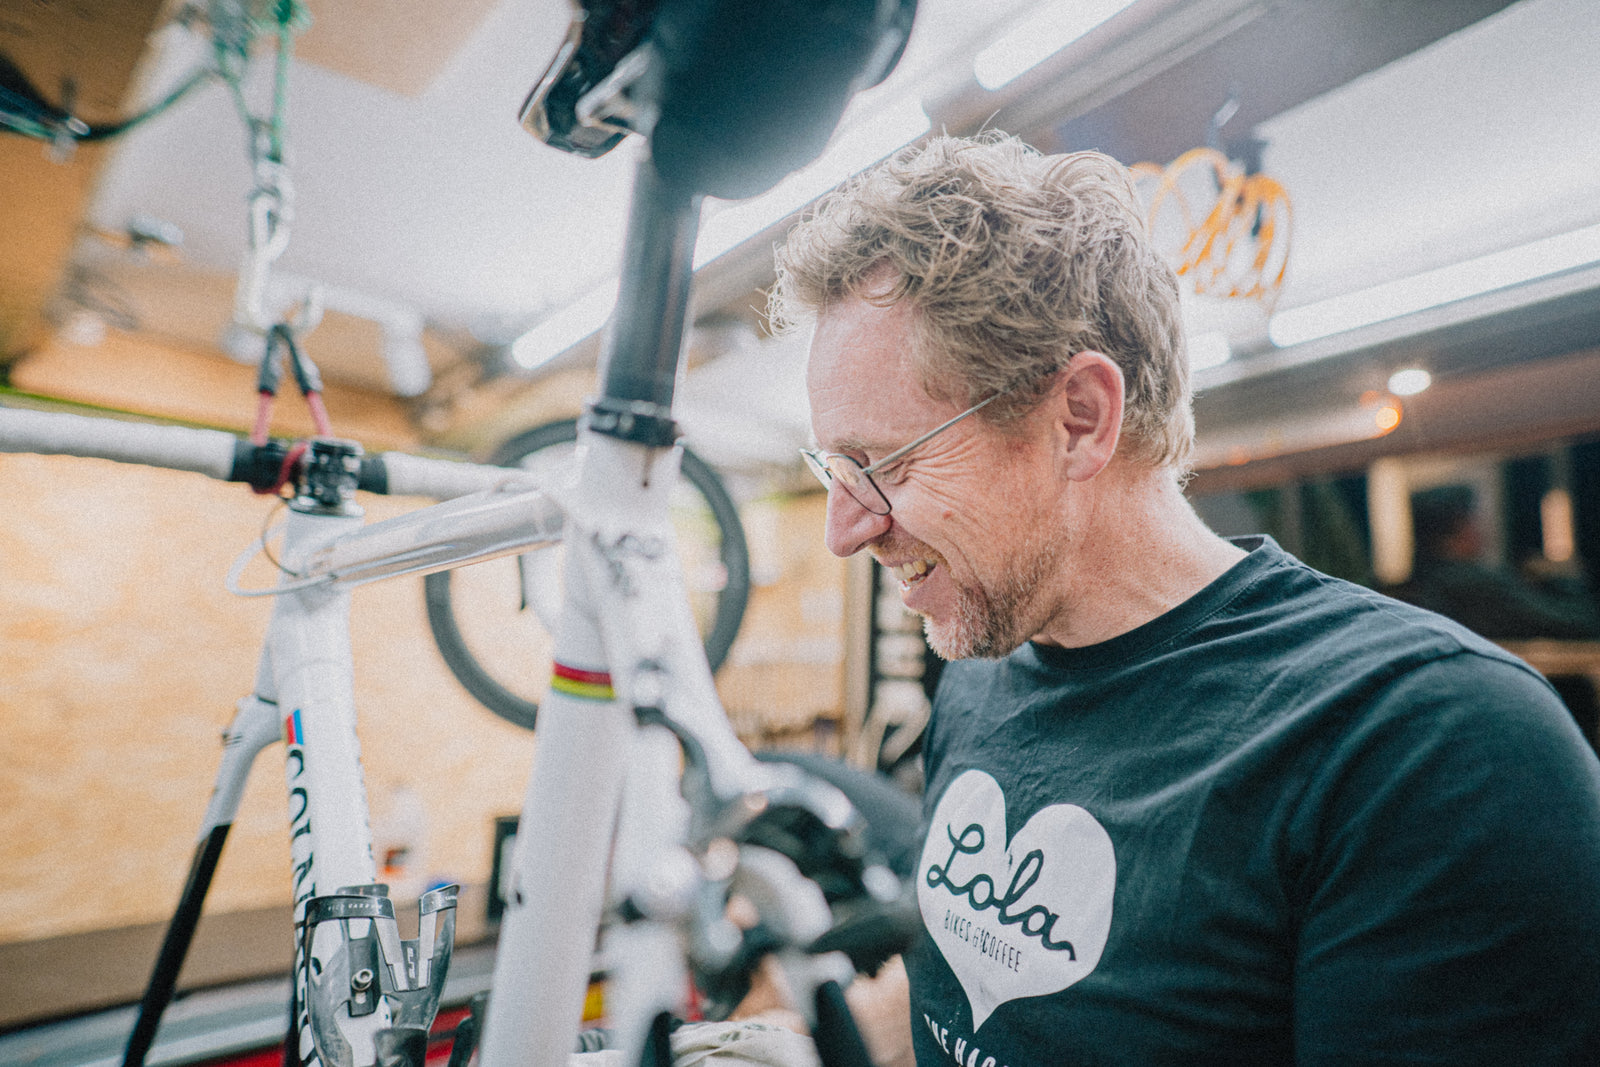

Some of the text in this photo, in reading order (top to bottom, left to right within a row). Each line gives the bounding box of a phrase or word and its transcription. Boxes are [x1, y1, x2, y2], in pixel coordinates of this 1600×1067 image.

[926, 822, 1077, 961] Lola
[944, 909, 972, 942] BIKES
[982, 931, 1022, 973] COFFEE
